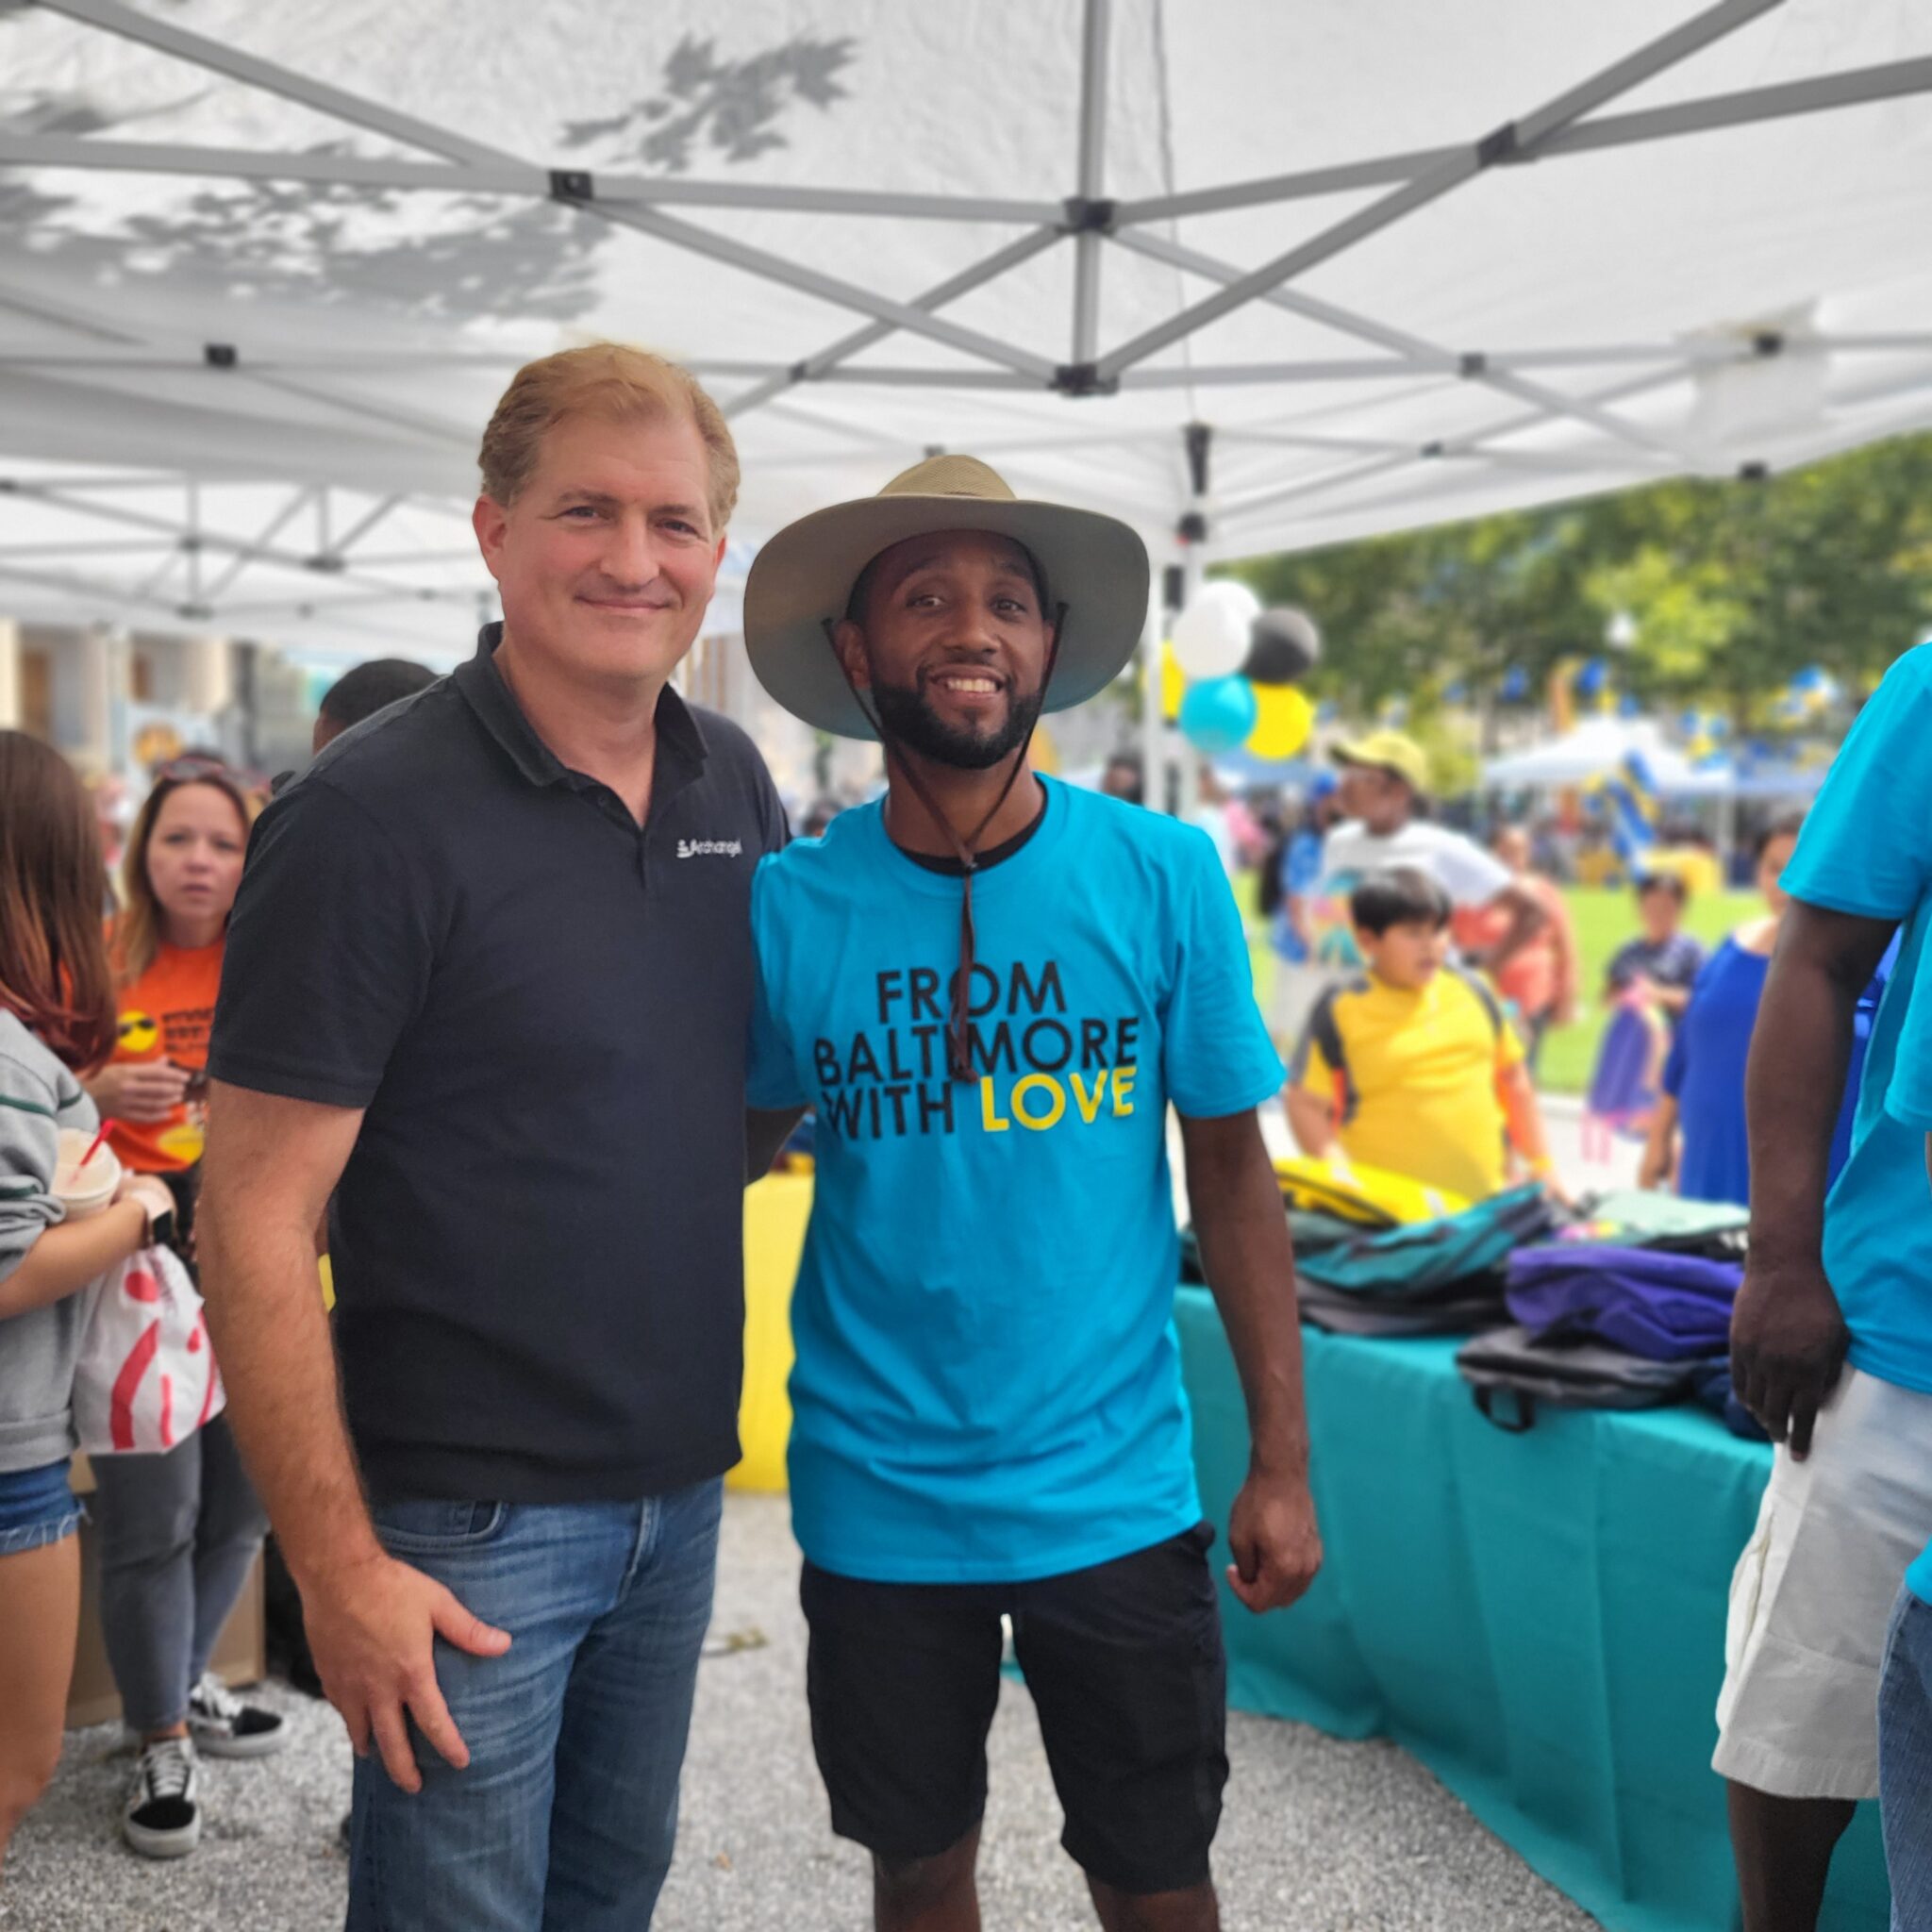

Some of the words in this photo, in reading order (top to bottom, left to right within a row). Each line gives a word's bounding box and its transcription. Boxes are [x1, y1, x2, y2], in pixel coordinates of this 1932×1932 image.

[876, 961, 1067, 1024] FROM
[814, 1018, 1139, 1086] BALTIMORE
[822, 1082, 955, 1140] WITH
[980, 1066, 1137, 1131] LOVE
